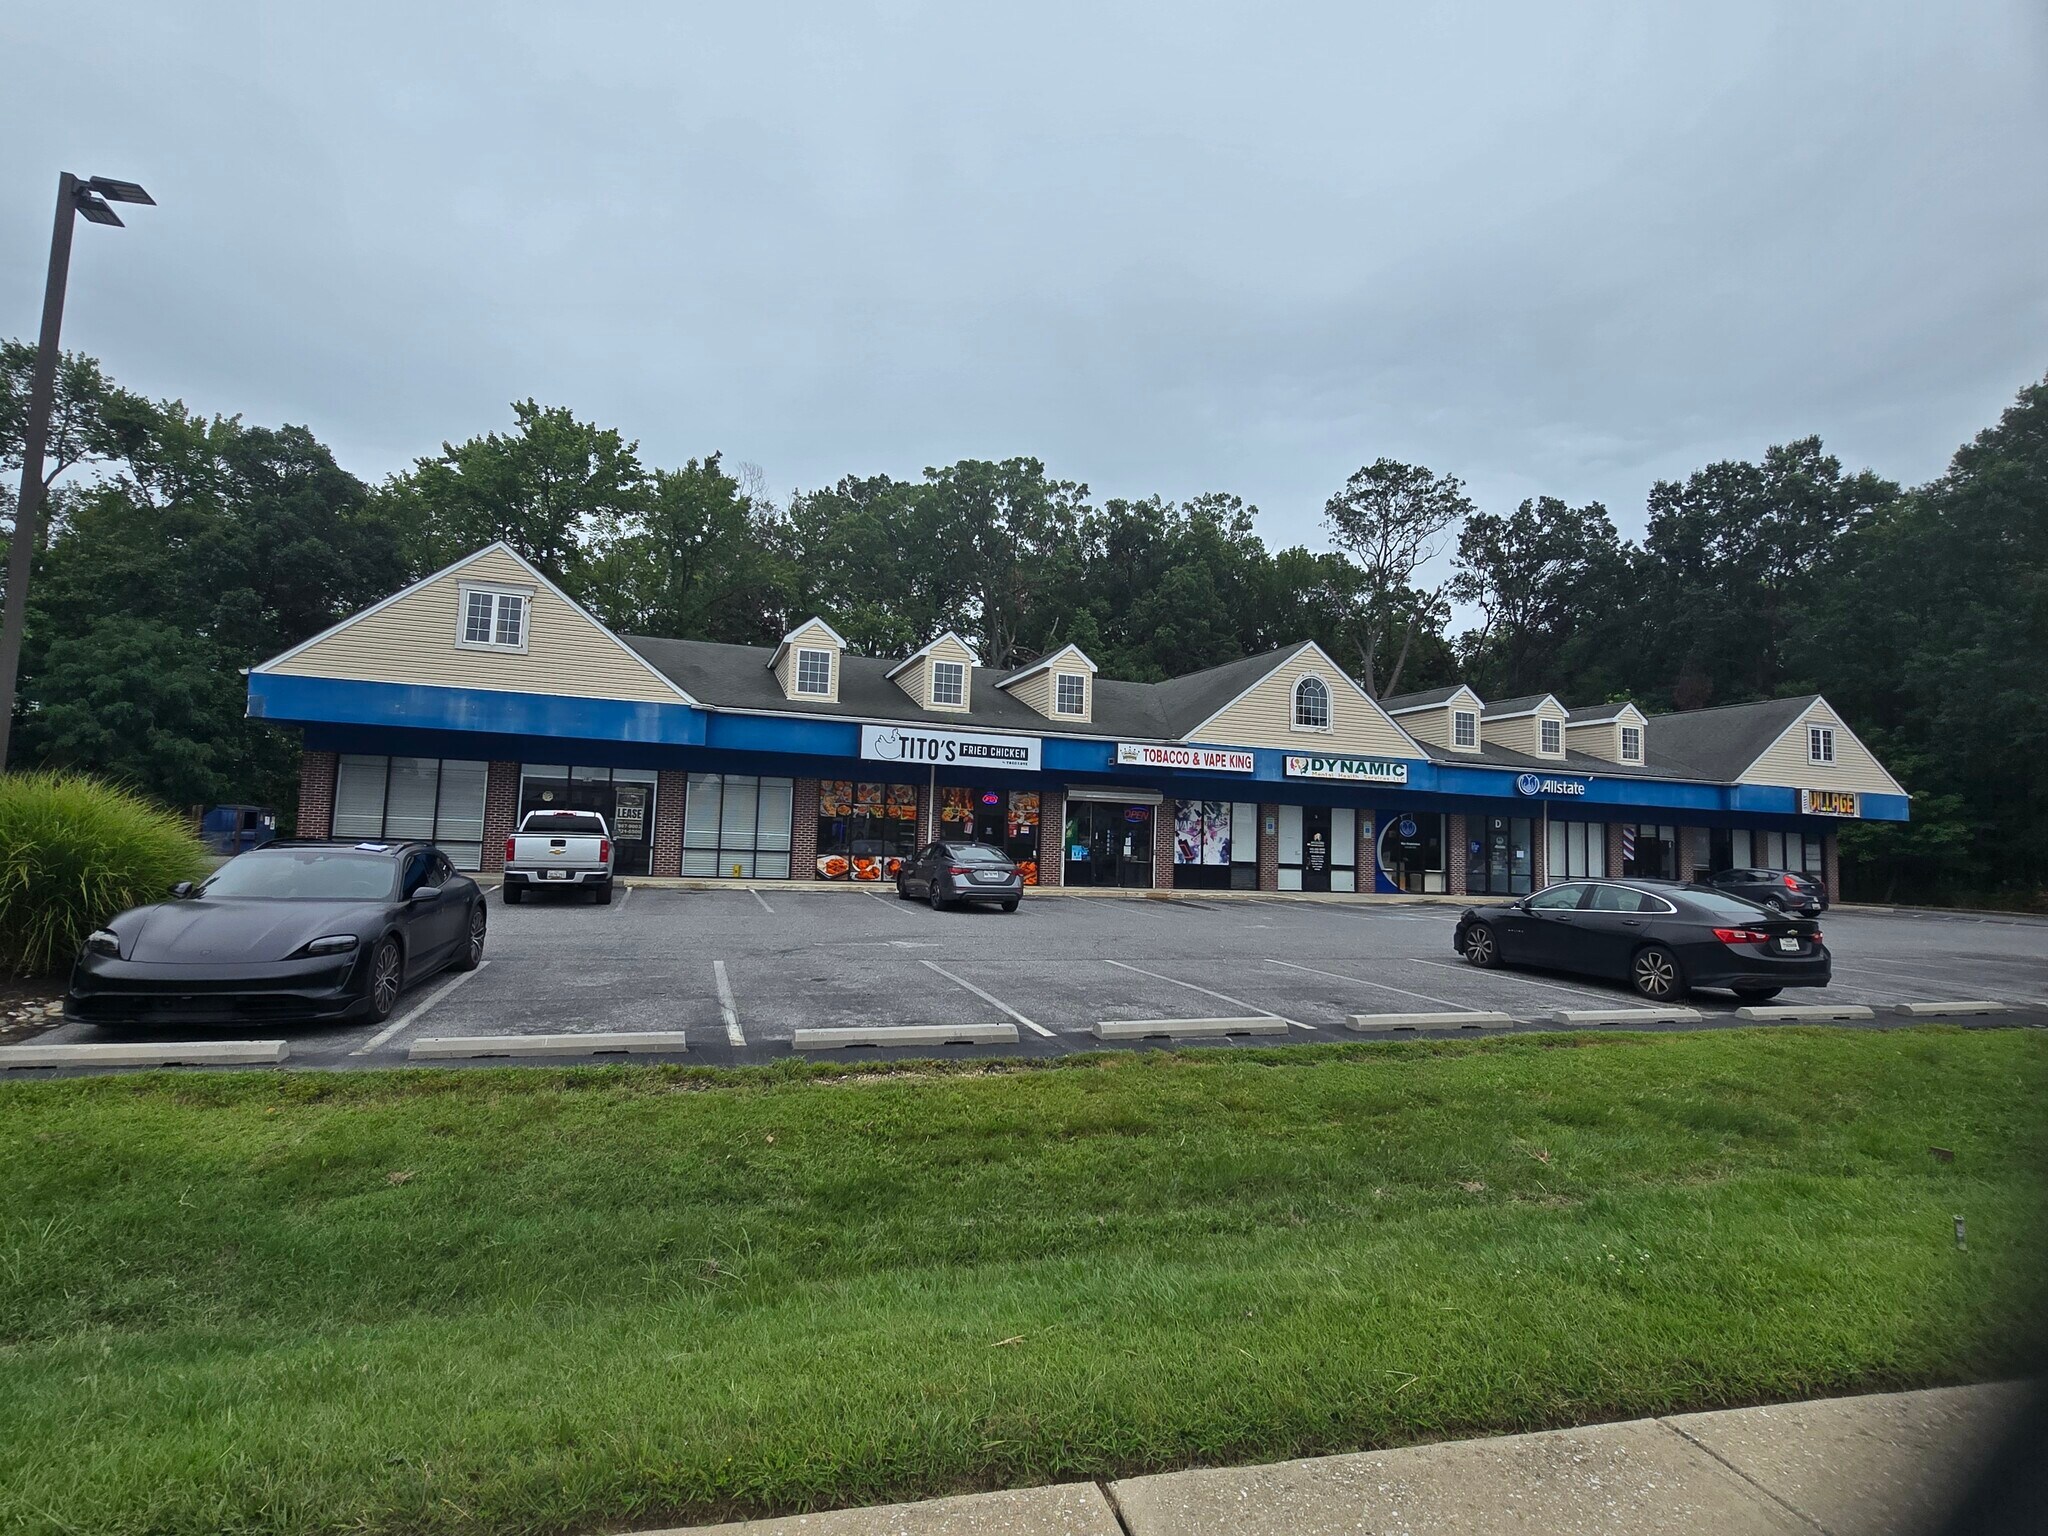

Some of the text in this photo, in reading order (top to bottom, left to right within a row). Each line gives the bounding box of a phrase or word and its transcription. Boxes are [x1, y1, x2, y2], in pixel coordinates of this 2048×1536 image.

[899, 736, 956, 762] TITO'S
[962, 745, 1026, 759] FRIED CHICKEN
[1143, 748, 1252, 769] TOBACCO & VAPE KING
[1311, 759, 1405, 777] DYNAMIC
[1540, 779, 1585, 795] Allstate
[1809, 791, 1854, 813] VILLAGE
[617, 808, 642, 819] LEASE
[1124, 809, 1150, 820] OPEN
[1495, 819, 1502, 828] D
